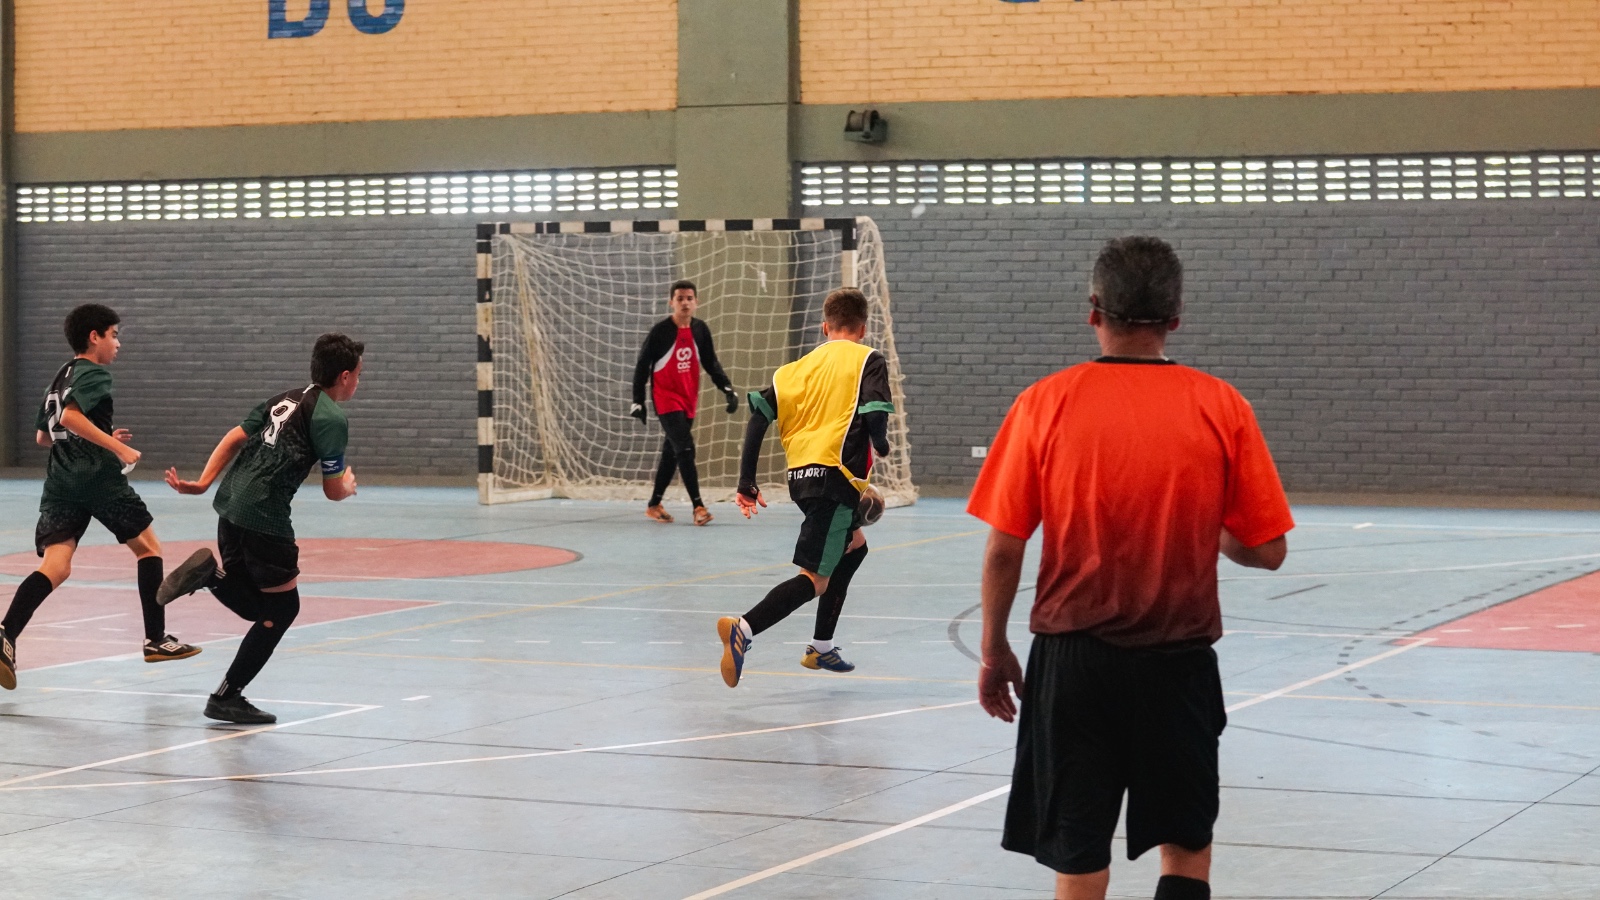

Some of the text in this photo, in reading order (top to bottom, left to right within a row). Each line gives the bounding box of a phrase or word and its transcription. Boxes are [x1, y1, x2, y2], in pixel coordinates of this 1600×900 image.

[44, 389, 72, 442] 2
[261, 397, 299, 448] 9
[804, 467, 827, 478] NORT
